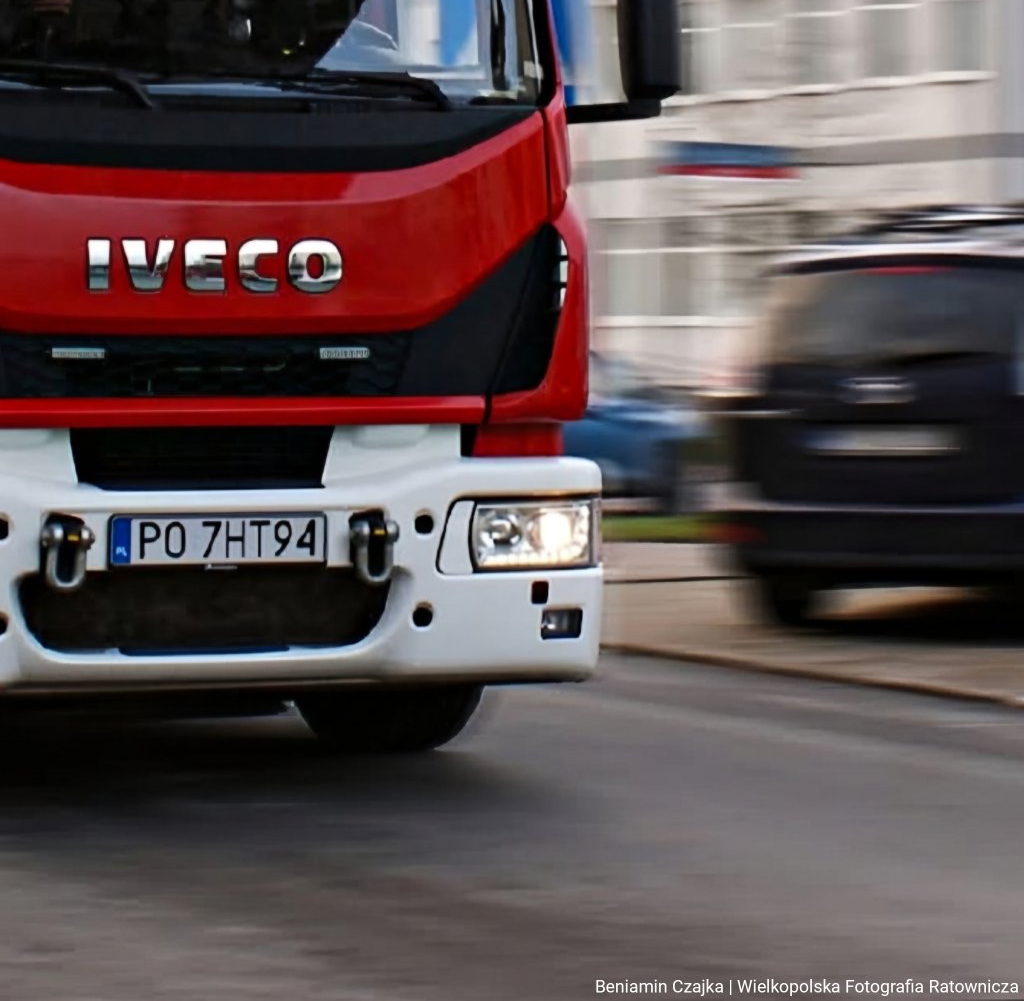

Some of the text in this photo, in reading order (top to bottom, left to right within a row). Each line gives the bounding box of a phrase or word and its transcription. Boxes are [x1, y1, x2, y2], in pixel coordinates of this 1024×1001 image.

[86, 239, 343, 293] IVECO
[139, 521, 187, 559] PO
[202, 519, 316, 559] 7HT94
